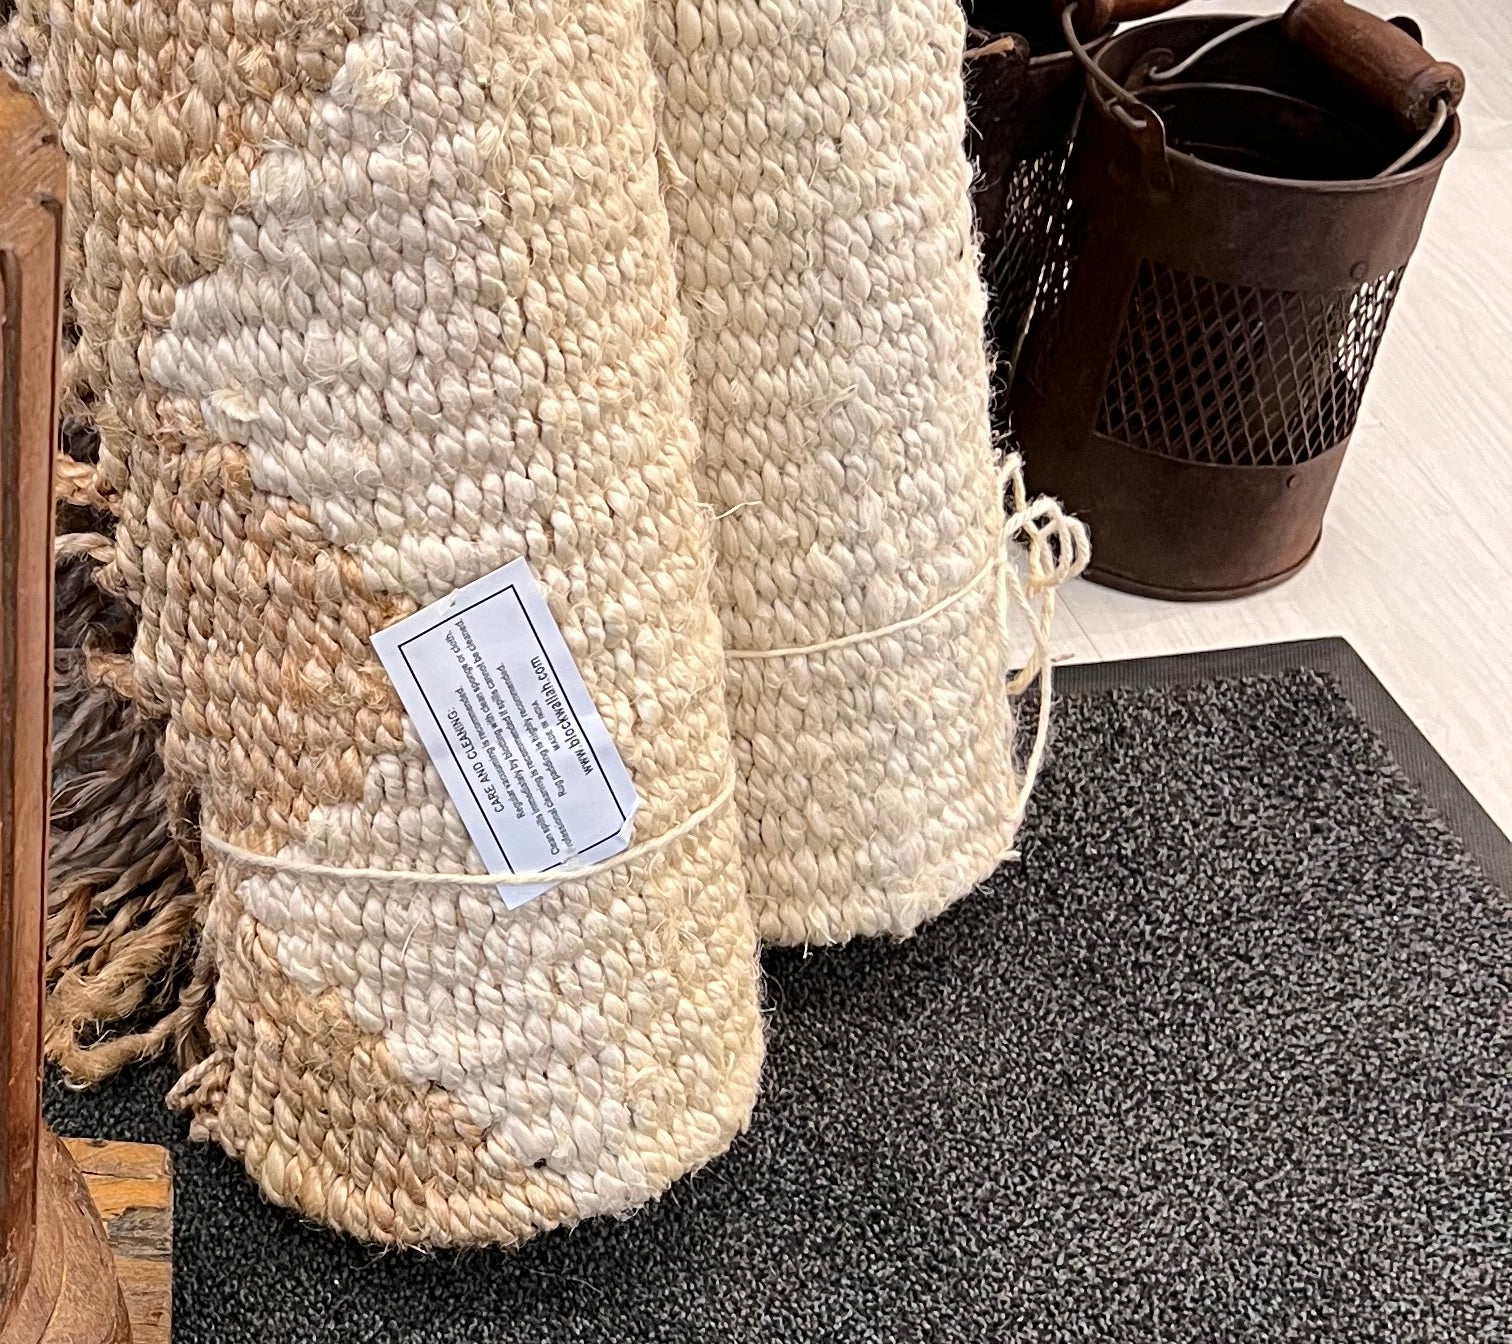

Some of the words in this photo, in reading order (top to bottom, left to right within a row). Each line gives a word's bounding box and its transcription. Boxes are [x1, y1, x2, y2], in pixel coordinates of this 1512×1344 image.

[445, 630, 461, 654] cloth.
[454, 618, 477, 652] cleaned.
[455, 654, 466, 664] or
[472, 651, 483, 664] be
[461, 663, 481, 693] sponge
[476, 661, 496, 690] cannot
[475, 691, 491, 714] clean
[484, 712, 498, 730] with
[530, 656, 593, 775] www.blockwallah.com
[447, 707, 478, 760] CLEANING:
[523, 717, 540, 743] highly
[545, 729, 561, 752] MADE
[472, 761, 491, 783] AND
[508, 758, 519, 771] by
[483, 784, 505, 813] CARE
[534, 775, 554, 808] cleaning
[554, 779, 567, 798] Rug
[547, 807, 573, 848] rofessional
[545, 833, 561, 856] Clean
